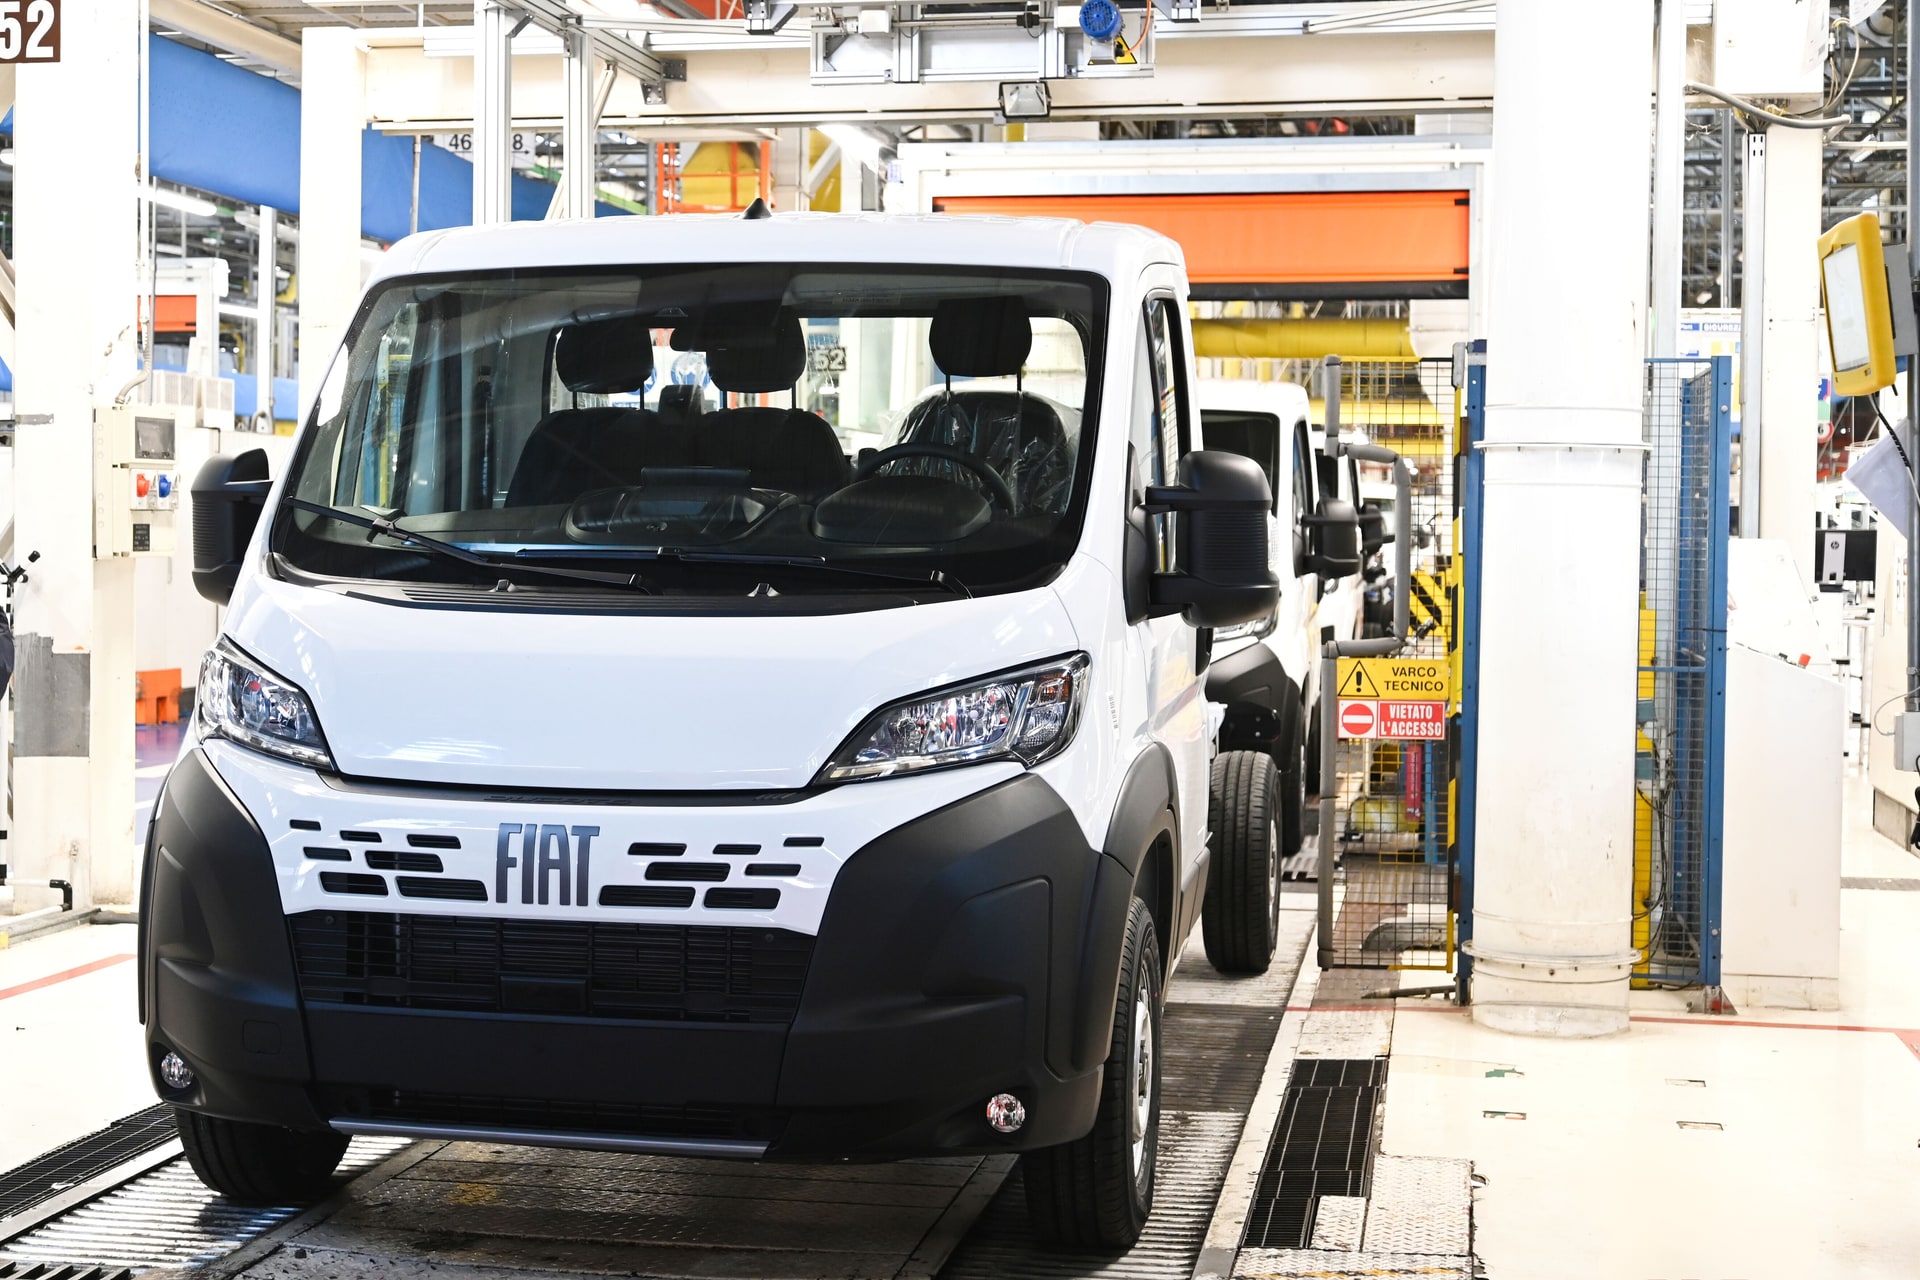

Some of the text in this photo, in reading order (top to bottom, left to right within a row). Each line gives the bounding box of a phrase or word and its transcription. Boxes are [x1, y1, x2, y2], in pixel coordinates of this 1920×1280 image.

[0, 0, 55, 60] 52
[449, 134, 472, 150] 46
[814, 348, 844, 370] 52
[1391, 667, 1437, 677] VARCO
[1384, 681, 1444, 692] TECNICO
[1389, 704, 1433, 719] VIETATO
[1380, 721, 1442, 736] L'ACCESSO
[496, 823, 600, 906] FIAT
